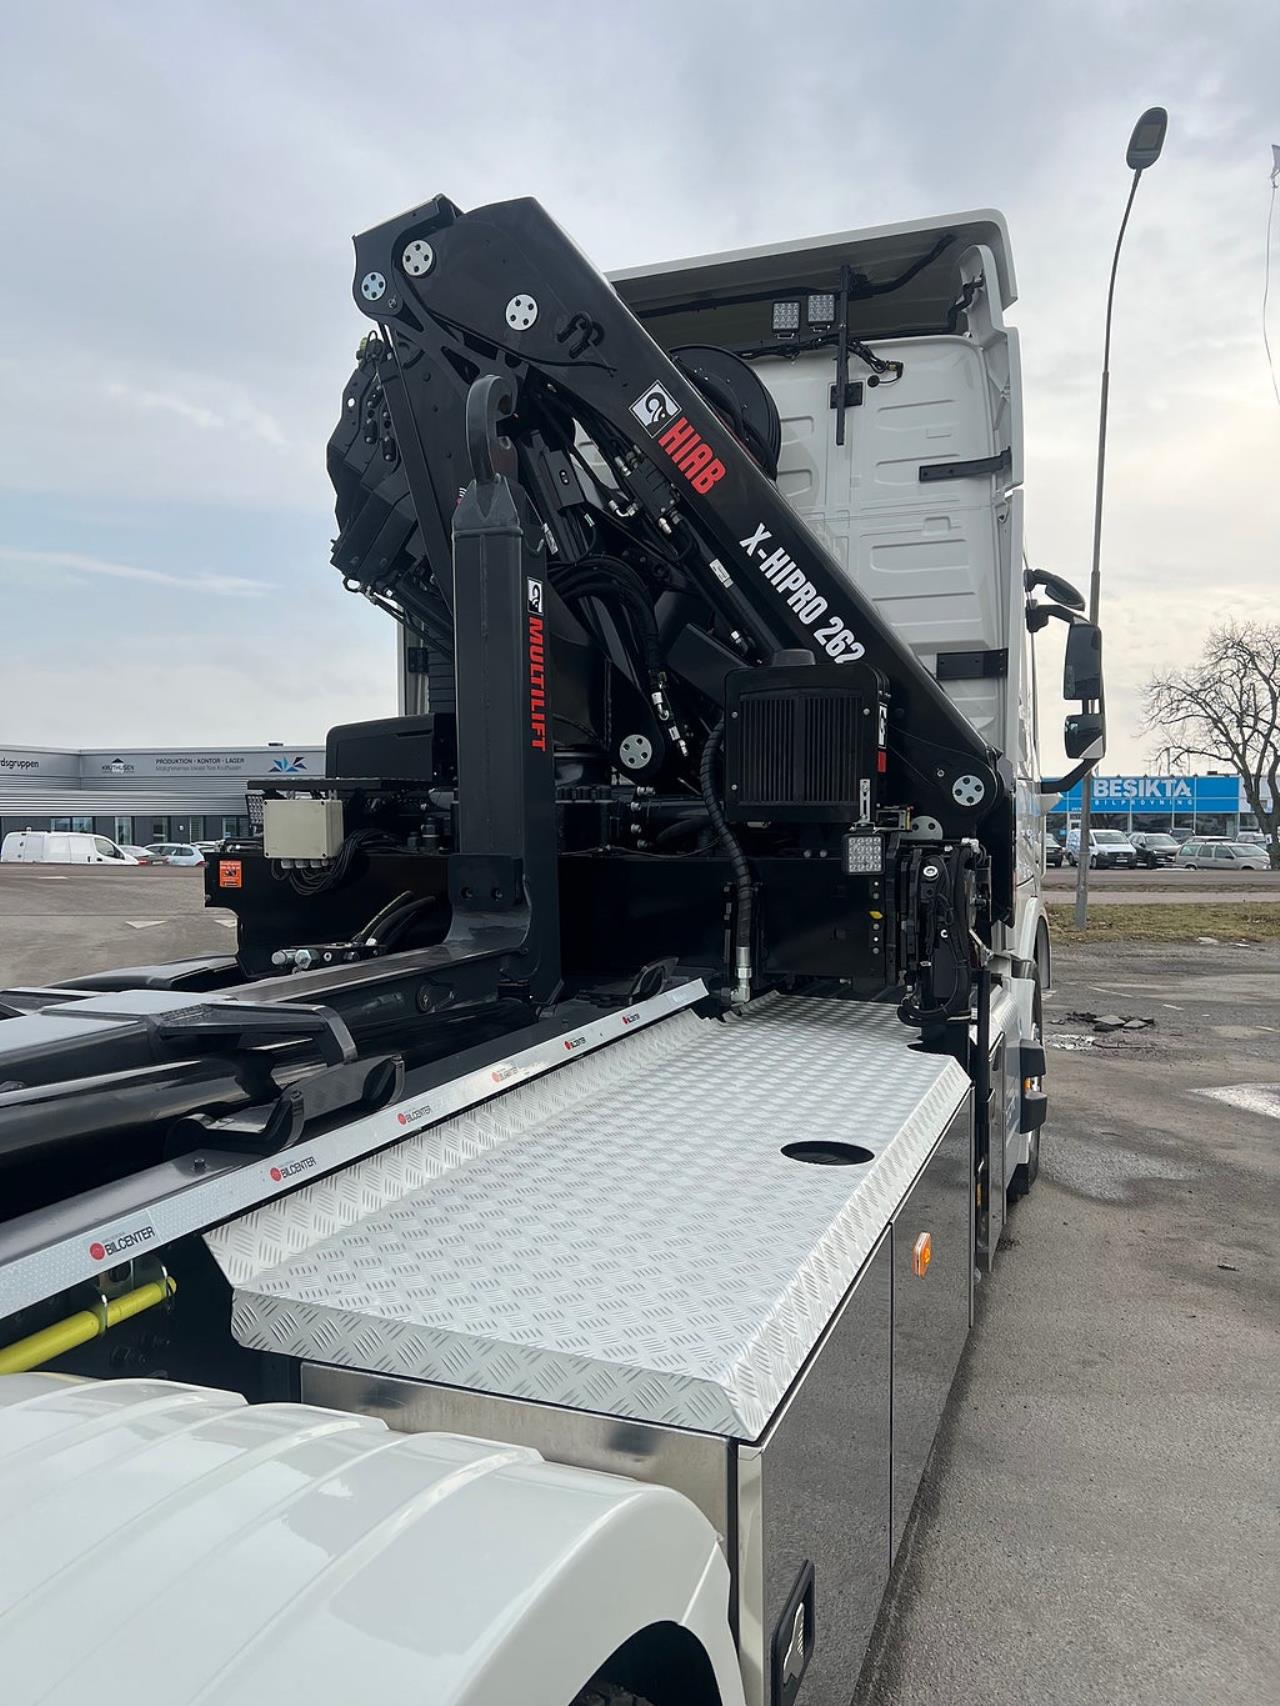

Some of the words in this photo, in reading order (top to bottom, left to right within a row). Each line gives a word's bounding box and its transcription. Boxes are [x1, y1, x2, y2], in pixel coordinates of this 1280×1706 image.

[658, 417, 727, 495] HIAB
[739, 522, 829, 625] X-HIPRO
[813, 616, 866, 664] 262
[528, 616, 546, 752] MULTILIFT
[1093, 779, 1192, 797] BESIKTA
[281, 1156, 317, 1178] BILCENTER
[104, 1226, 155, 1256] BILCENTER
